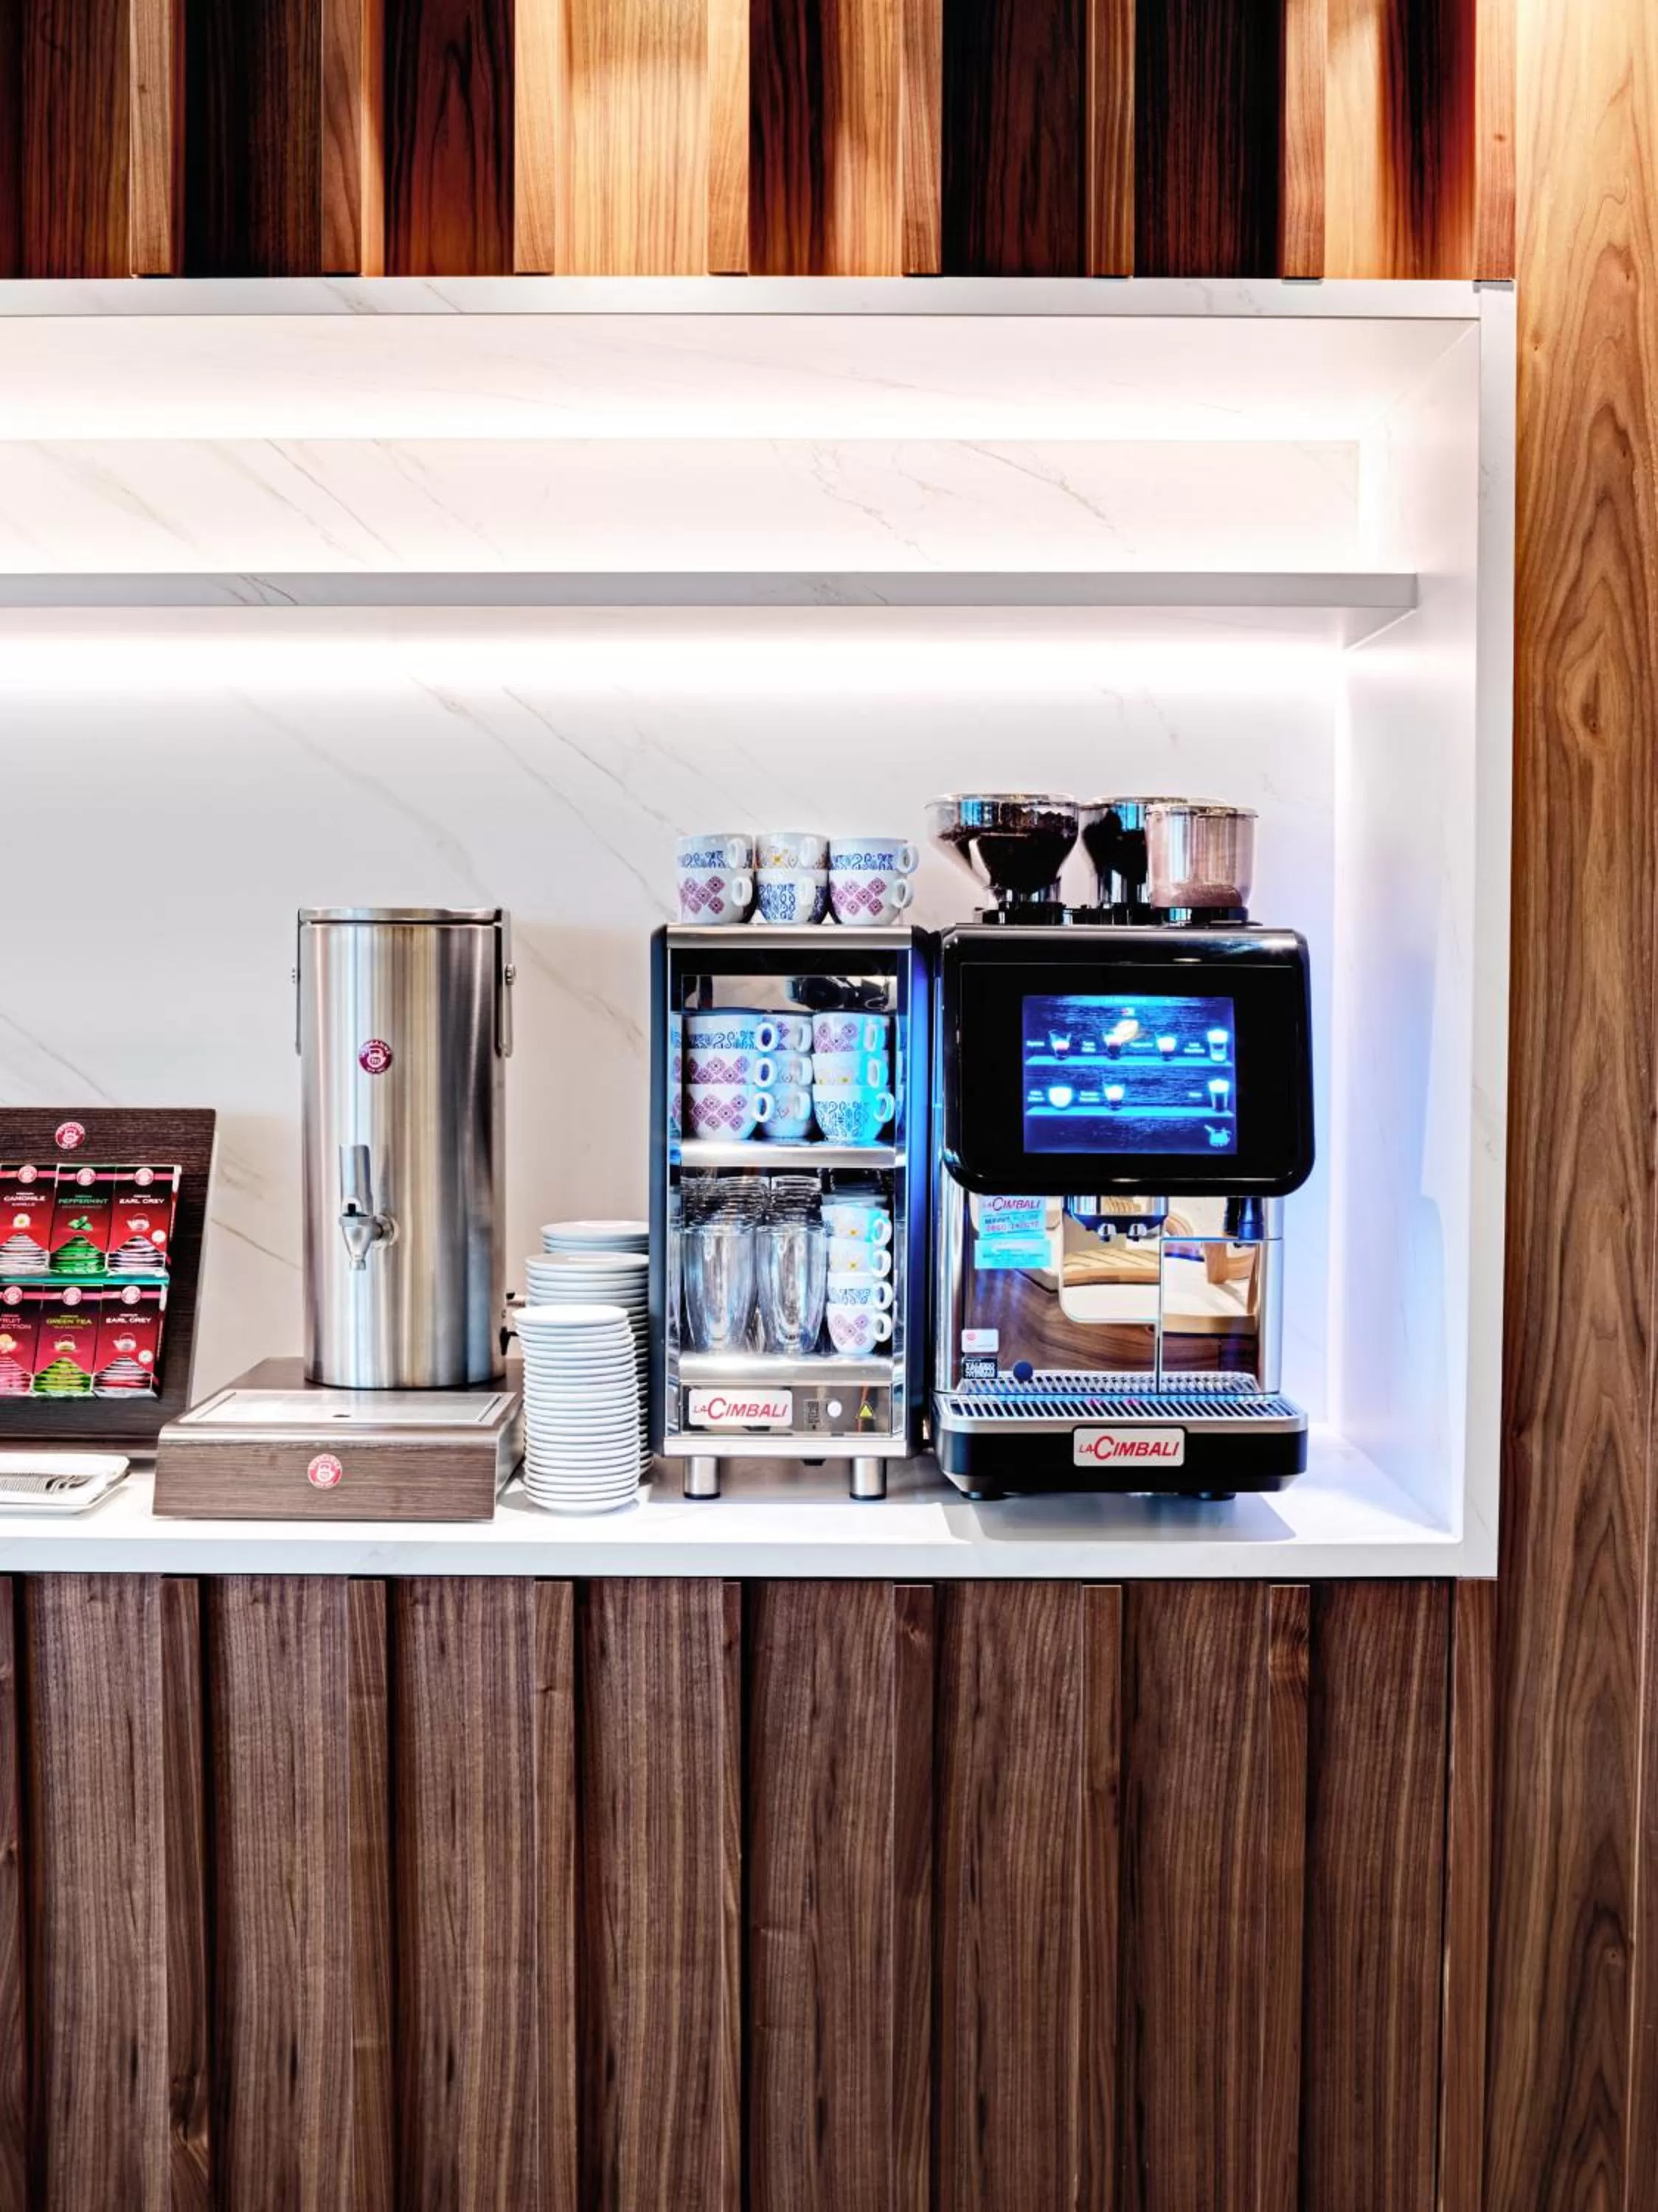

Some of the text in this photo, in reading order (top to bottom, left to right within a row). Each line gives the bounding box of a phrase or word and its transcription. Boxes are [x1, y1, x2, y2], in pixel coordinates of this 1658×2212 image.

[992, 1197, 1040, 1211] CIMBALI
[708, 1397, 788, 1419] CIMBALI
[1079, 1436, 1179, 1460] LA CIMBALI
